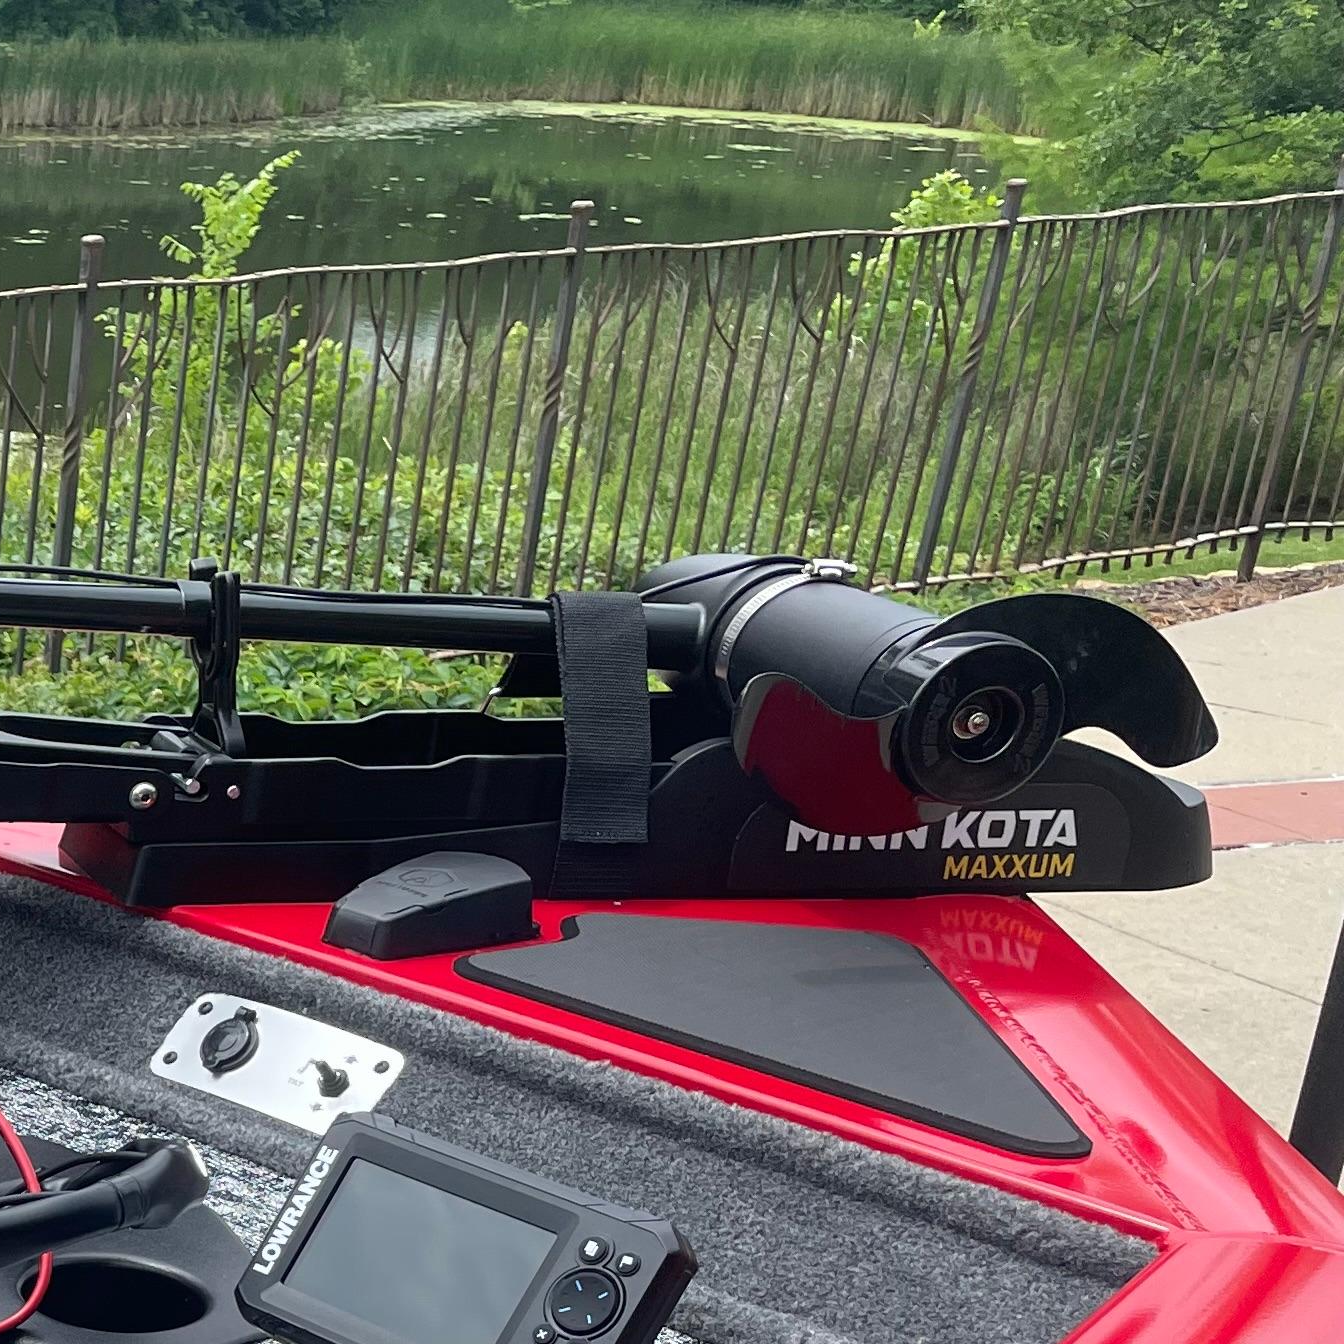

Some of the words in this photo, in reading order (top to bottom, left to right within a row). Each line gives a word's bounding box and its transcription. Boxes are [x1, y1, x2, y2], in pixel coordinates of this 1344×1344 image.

[940, 808, 1078, 849] KOTA
[942, 852, 1075, 880] MAXXUM
[252, 1145, 340, 1276] LOWRANCE
